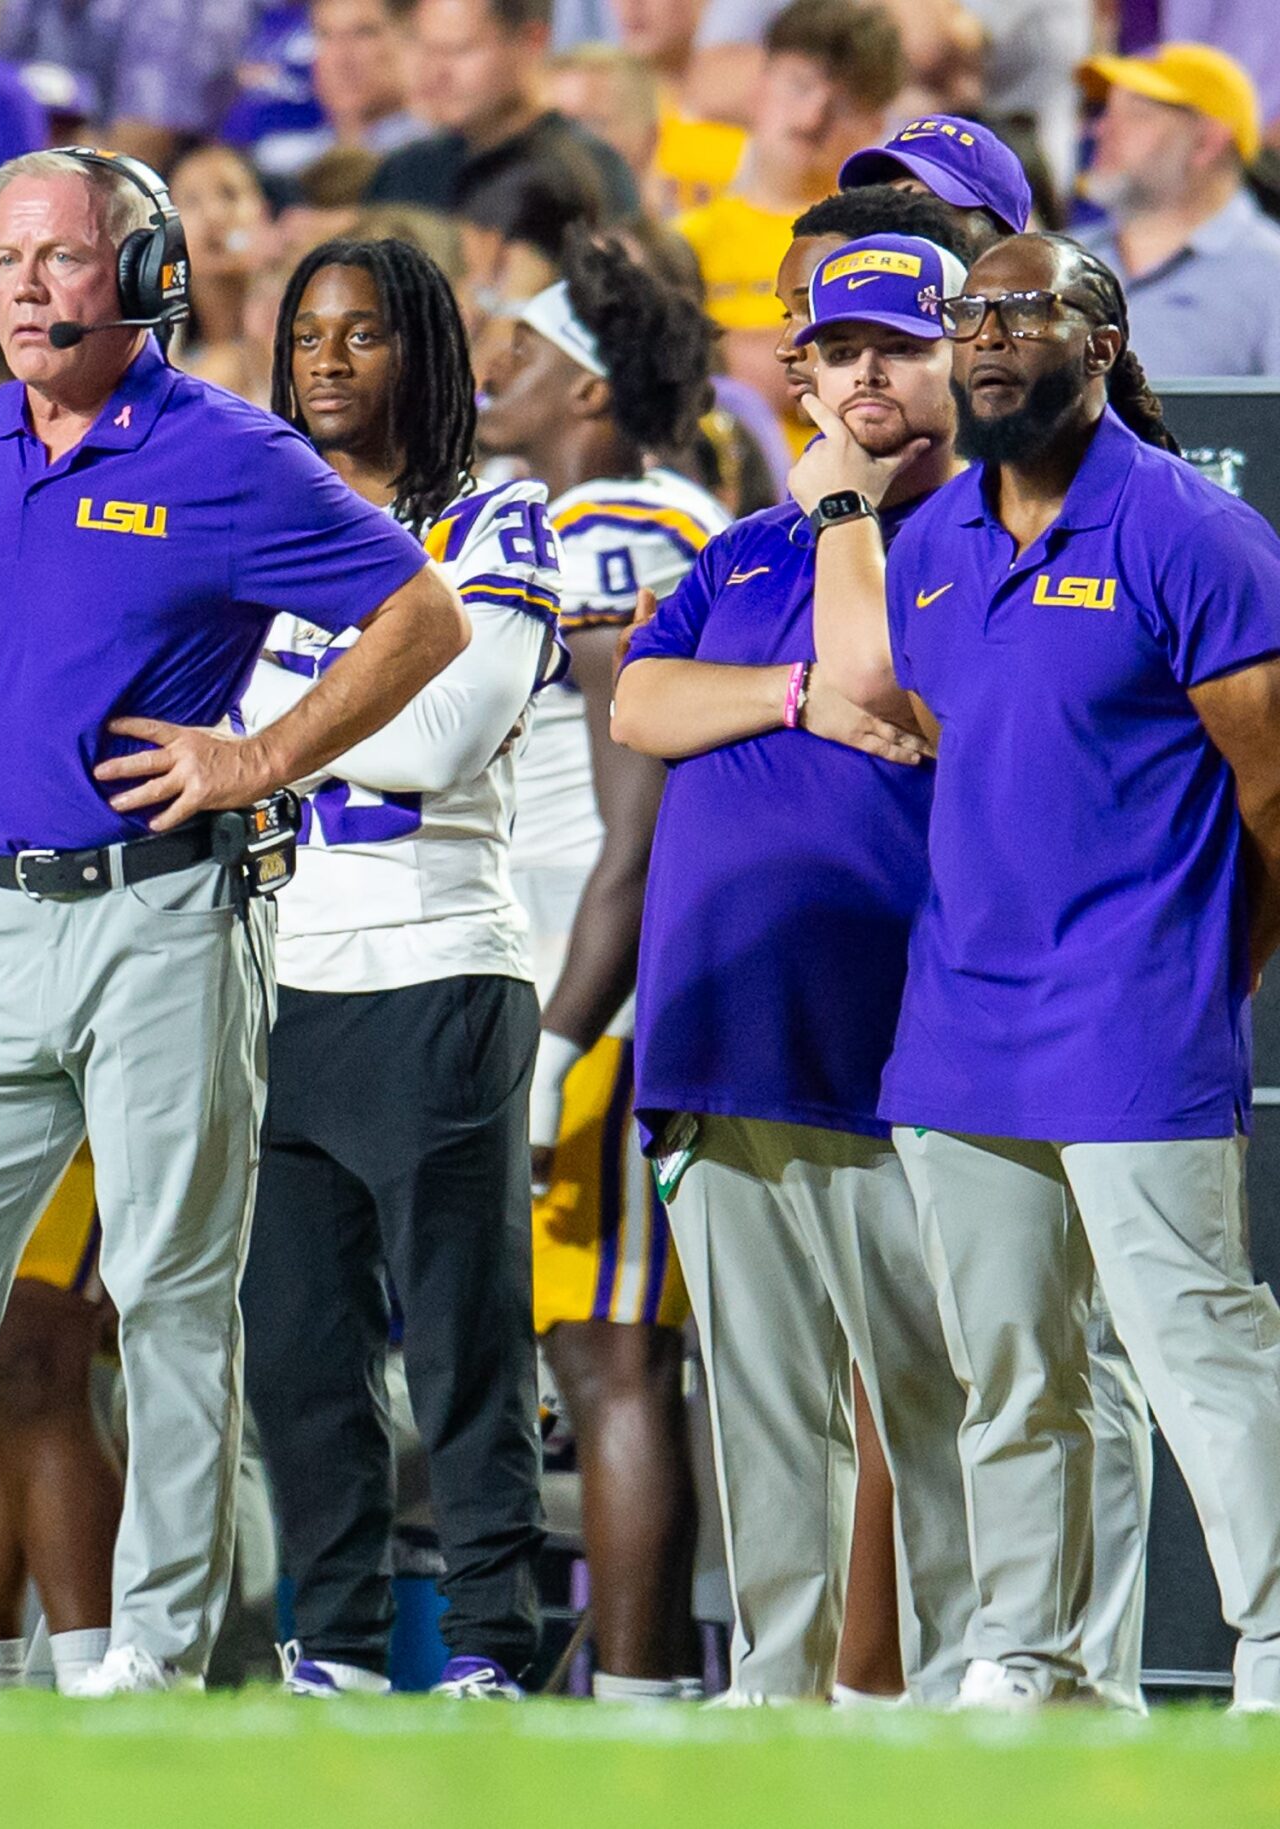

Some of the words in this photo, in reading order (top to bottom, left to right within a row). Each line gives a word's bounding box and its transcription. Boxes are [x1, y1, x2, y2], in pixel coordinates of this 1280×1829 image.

[830, 255, 910, 273] TIGERS
[76, 497, 167, 537] LSU
[1032, 574, 1117, 611] LSU
